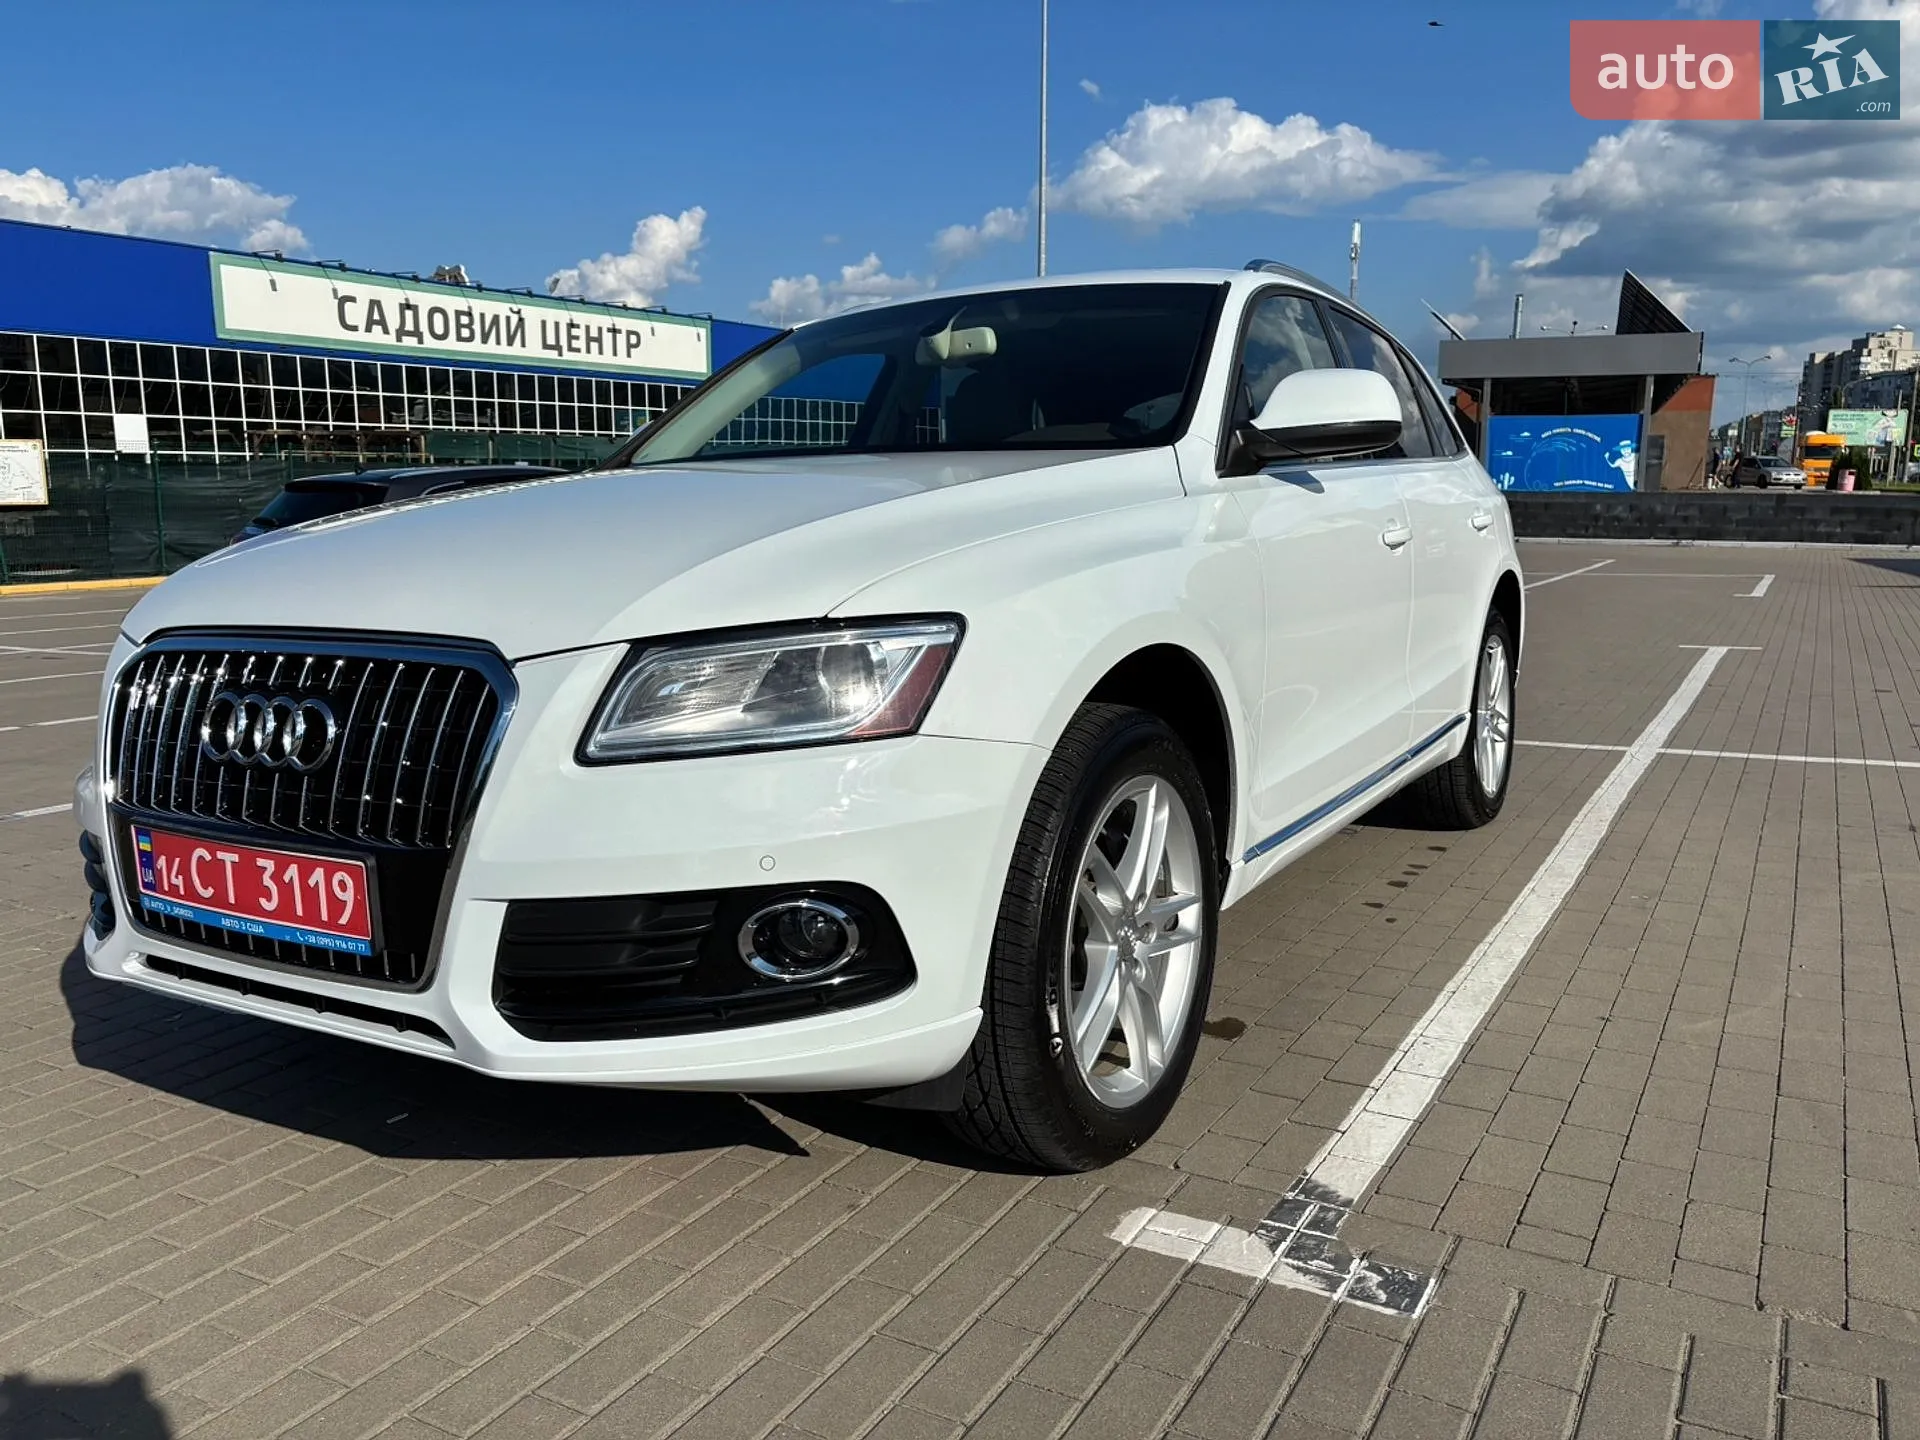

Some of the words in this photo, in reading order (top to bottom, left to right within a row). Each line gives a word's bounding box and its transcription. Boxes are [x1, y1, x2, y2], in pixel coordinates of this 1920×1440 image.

[336, 295, 526, 348] САДОВИЙ
[541, 318, 641, 358] ЦЕНТР
[141, 867, 155, 884] UA
[156, 855, 185, 896] 14
[190, 847, 239, 905] CT
[256, 857, 355, 925] 3119
[221, 917, 240, 929] АВТО
[246, 922, 264, 933] США
